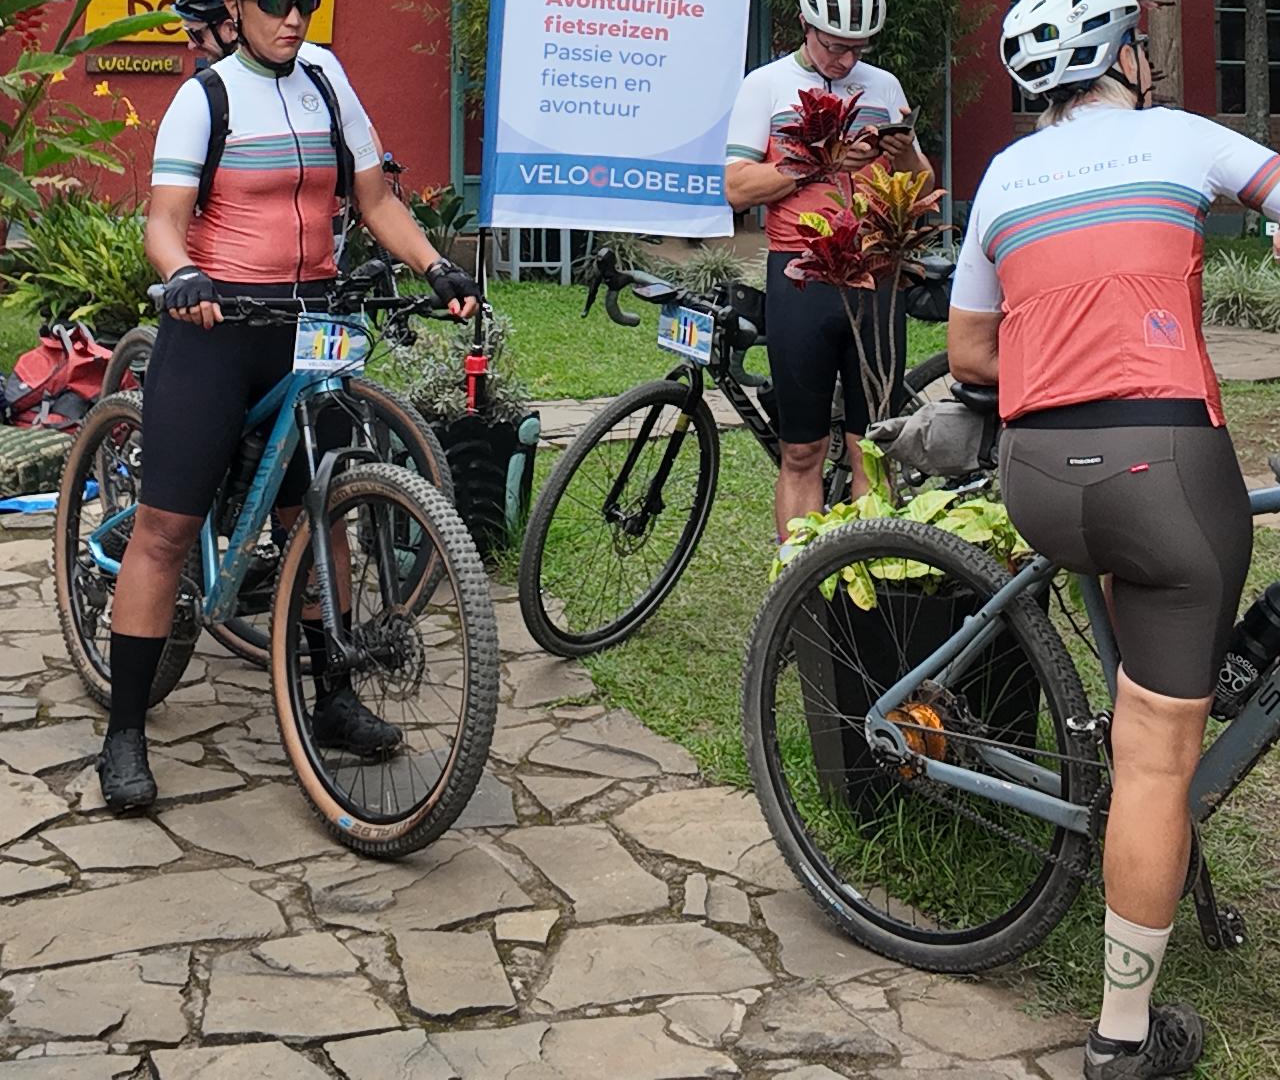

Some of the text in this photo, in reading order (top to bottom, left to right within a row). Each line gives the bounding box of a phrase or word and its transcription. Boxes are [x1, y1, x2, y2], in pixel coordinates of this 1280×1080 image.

[544, 15, 670, 42] fietsreizen
[543, 42, 668, 68] Passie voor
[540, 68, 652, 93] fietsen en
[539, 96, 641, 119] avontuur
[519, 163, 722, 196] VELOGLOBE.BE
[1001, 152, 1153, 192] VELOGLOBE.BE
[322, 335, 343, 355] 17
